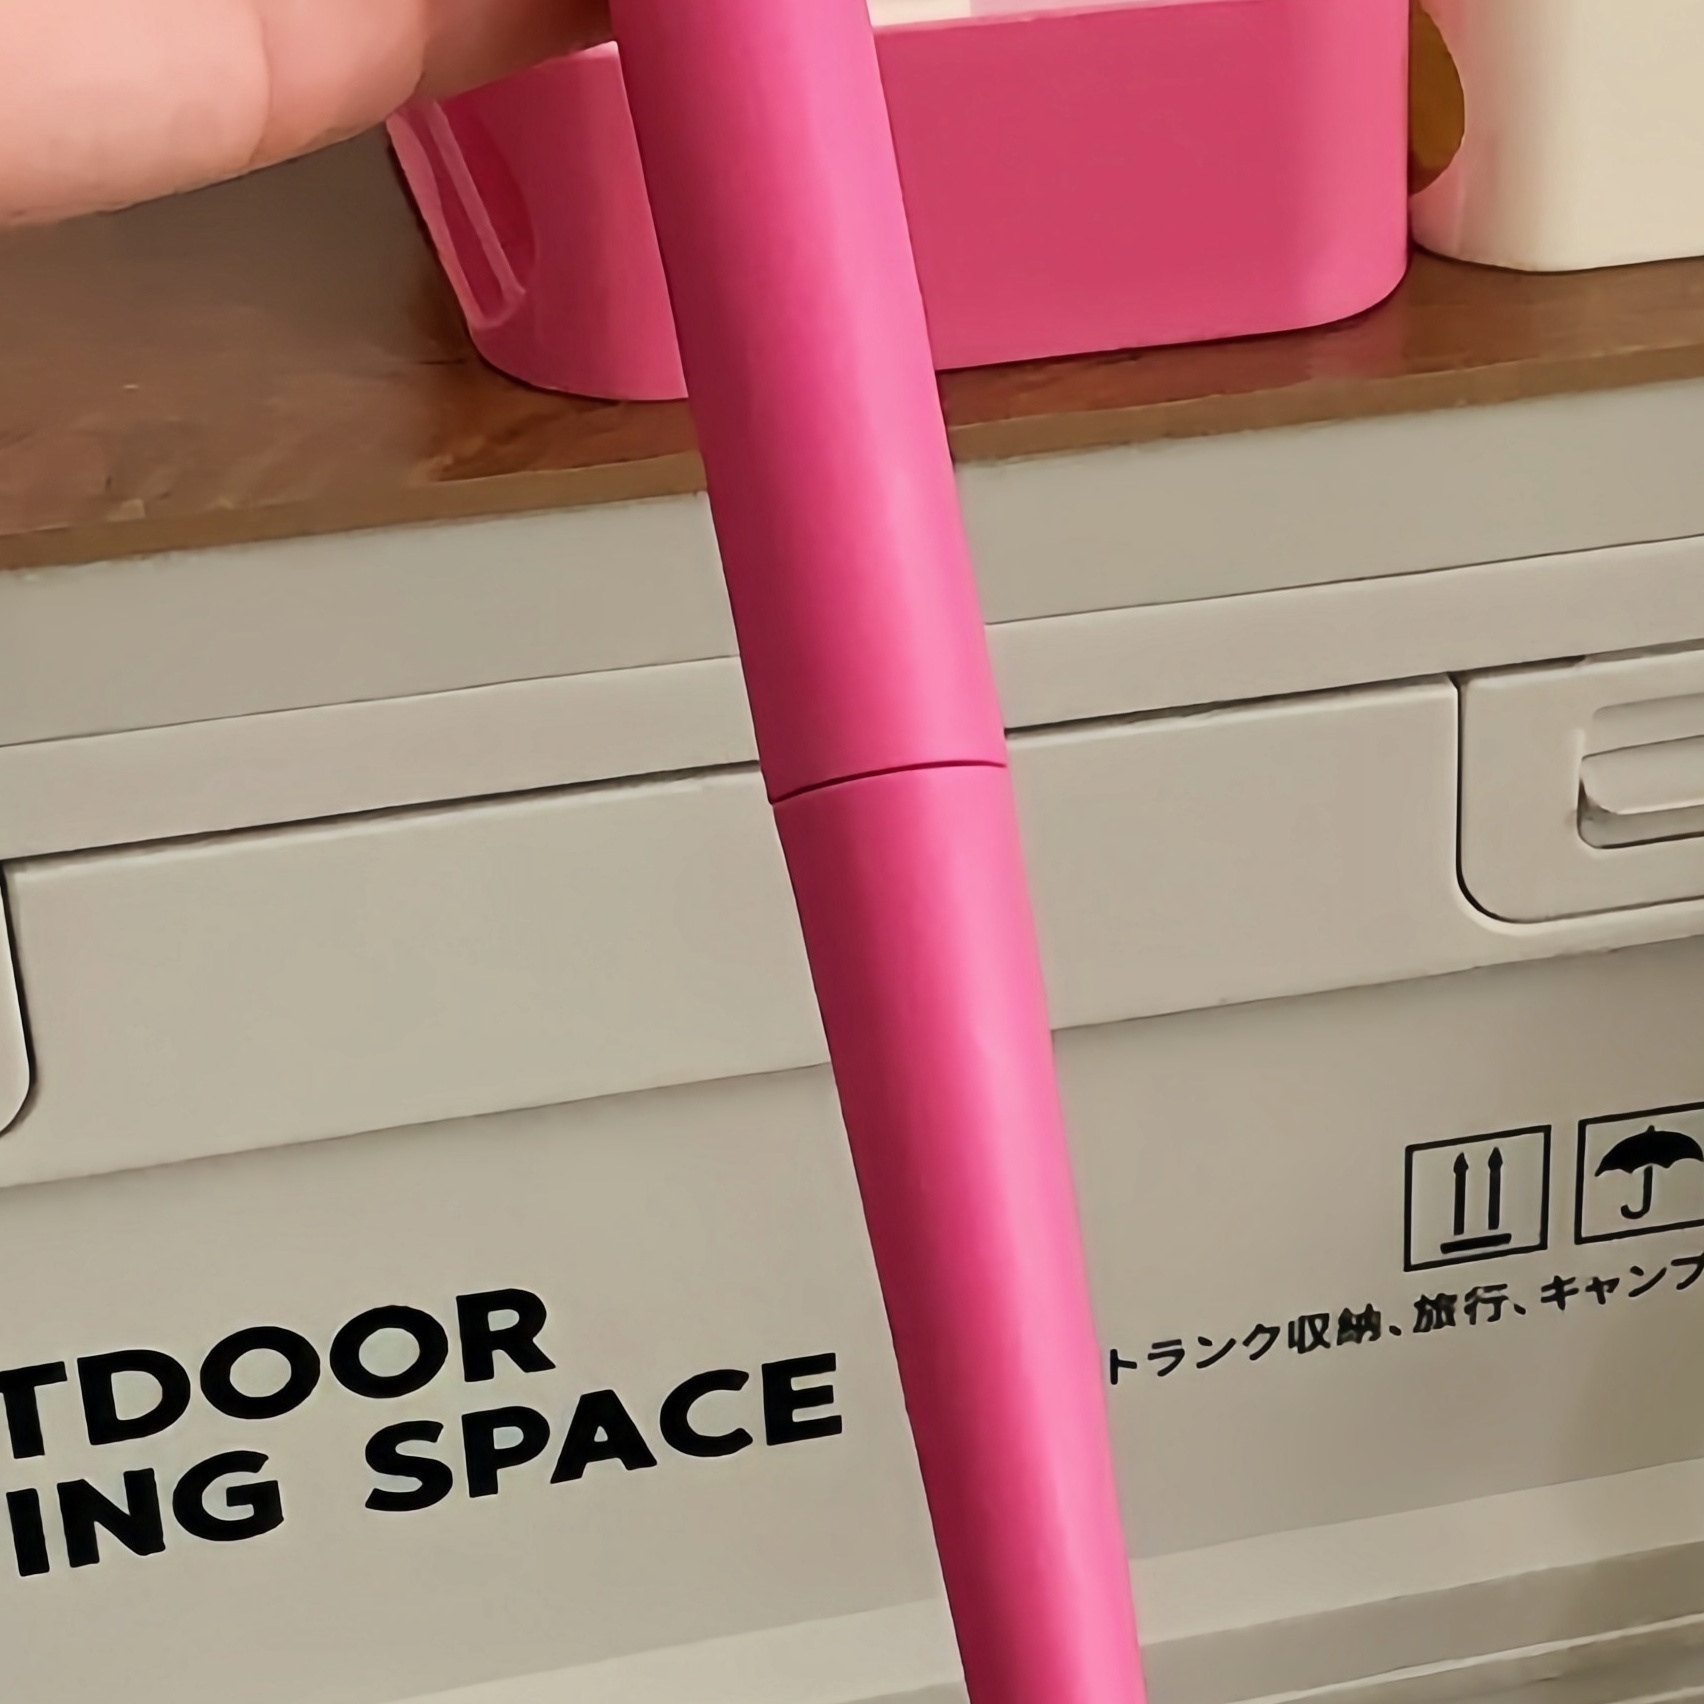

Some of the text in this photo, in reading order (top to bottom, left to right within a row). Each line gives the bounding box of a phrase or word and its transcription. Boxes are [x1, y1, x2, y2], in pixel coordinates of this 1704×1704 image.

[0, 1288, 556, 1460] TDOOR
[6, 1353, 843, 1577] ING SPACE
